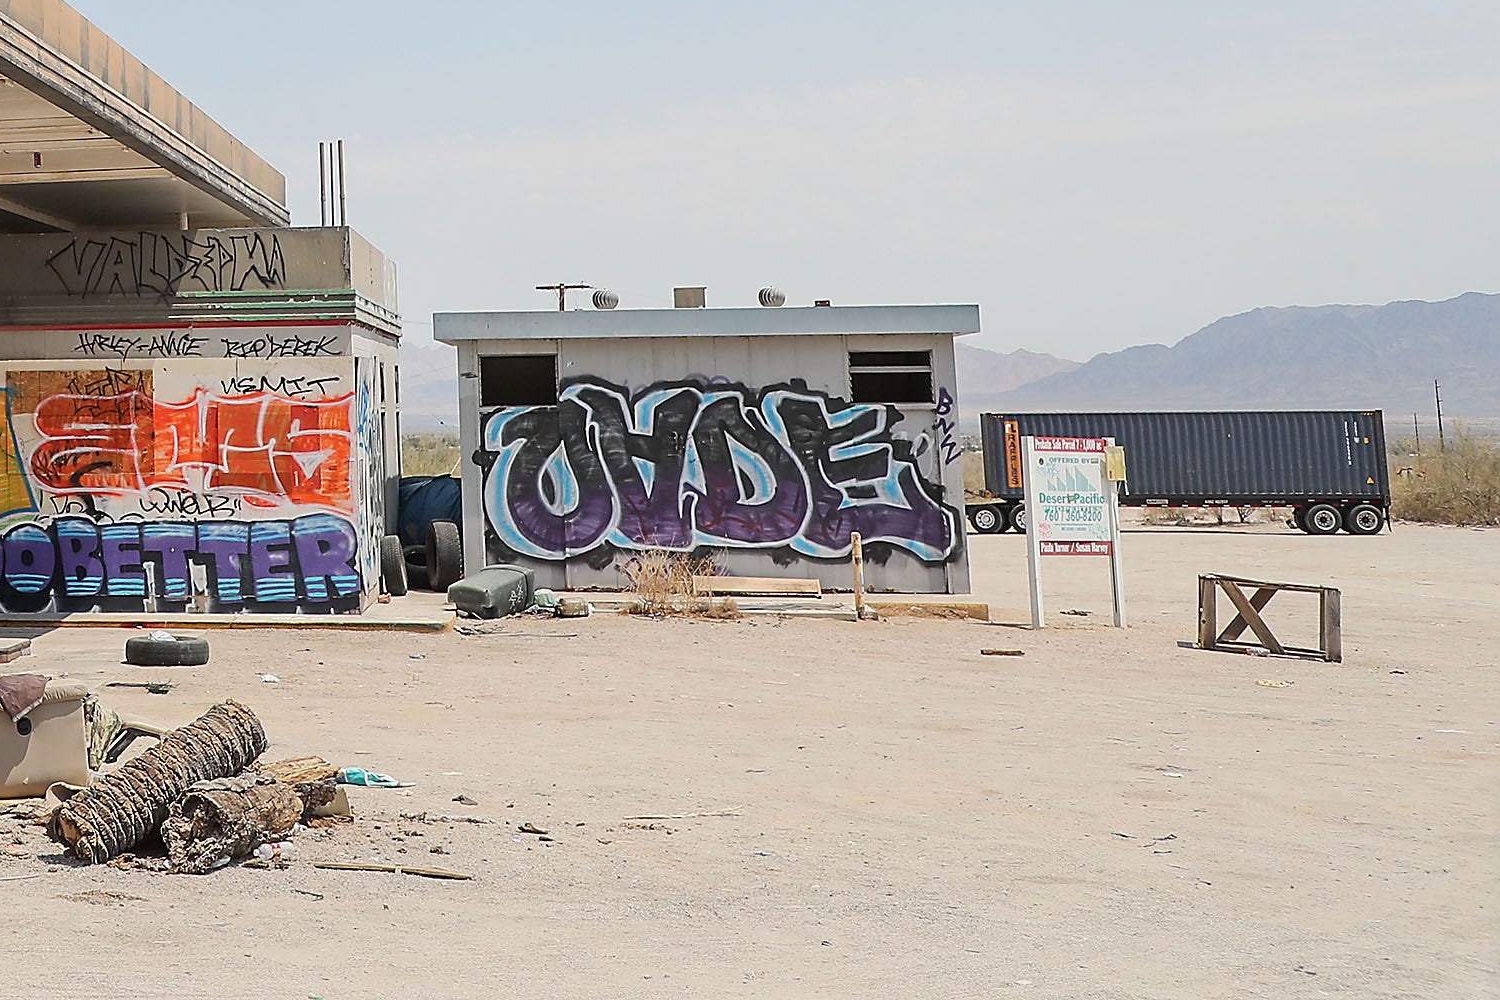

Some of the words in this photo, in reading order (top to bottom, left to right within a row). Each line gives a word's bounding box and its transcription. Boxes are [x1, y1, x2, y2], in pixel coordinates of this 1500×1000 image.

[1039, 492, 1071, 504] Desert
[1073, 492, 1105, 504] Pacific
[1044, 508, 1059, 522] 760
